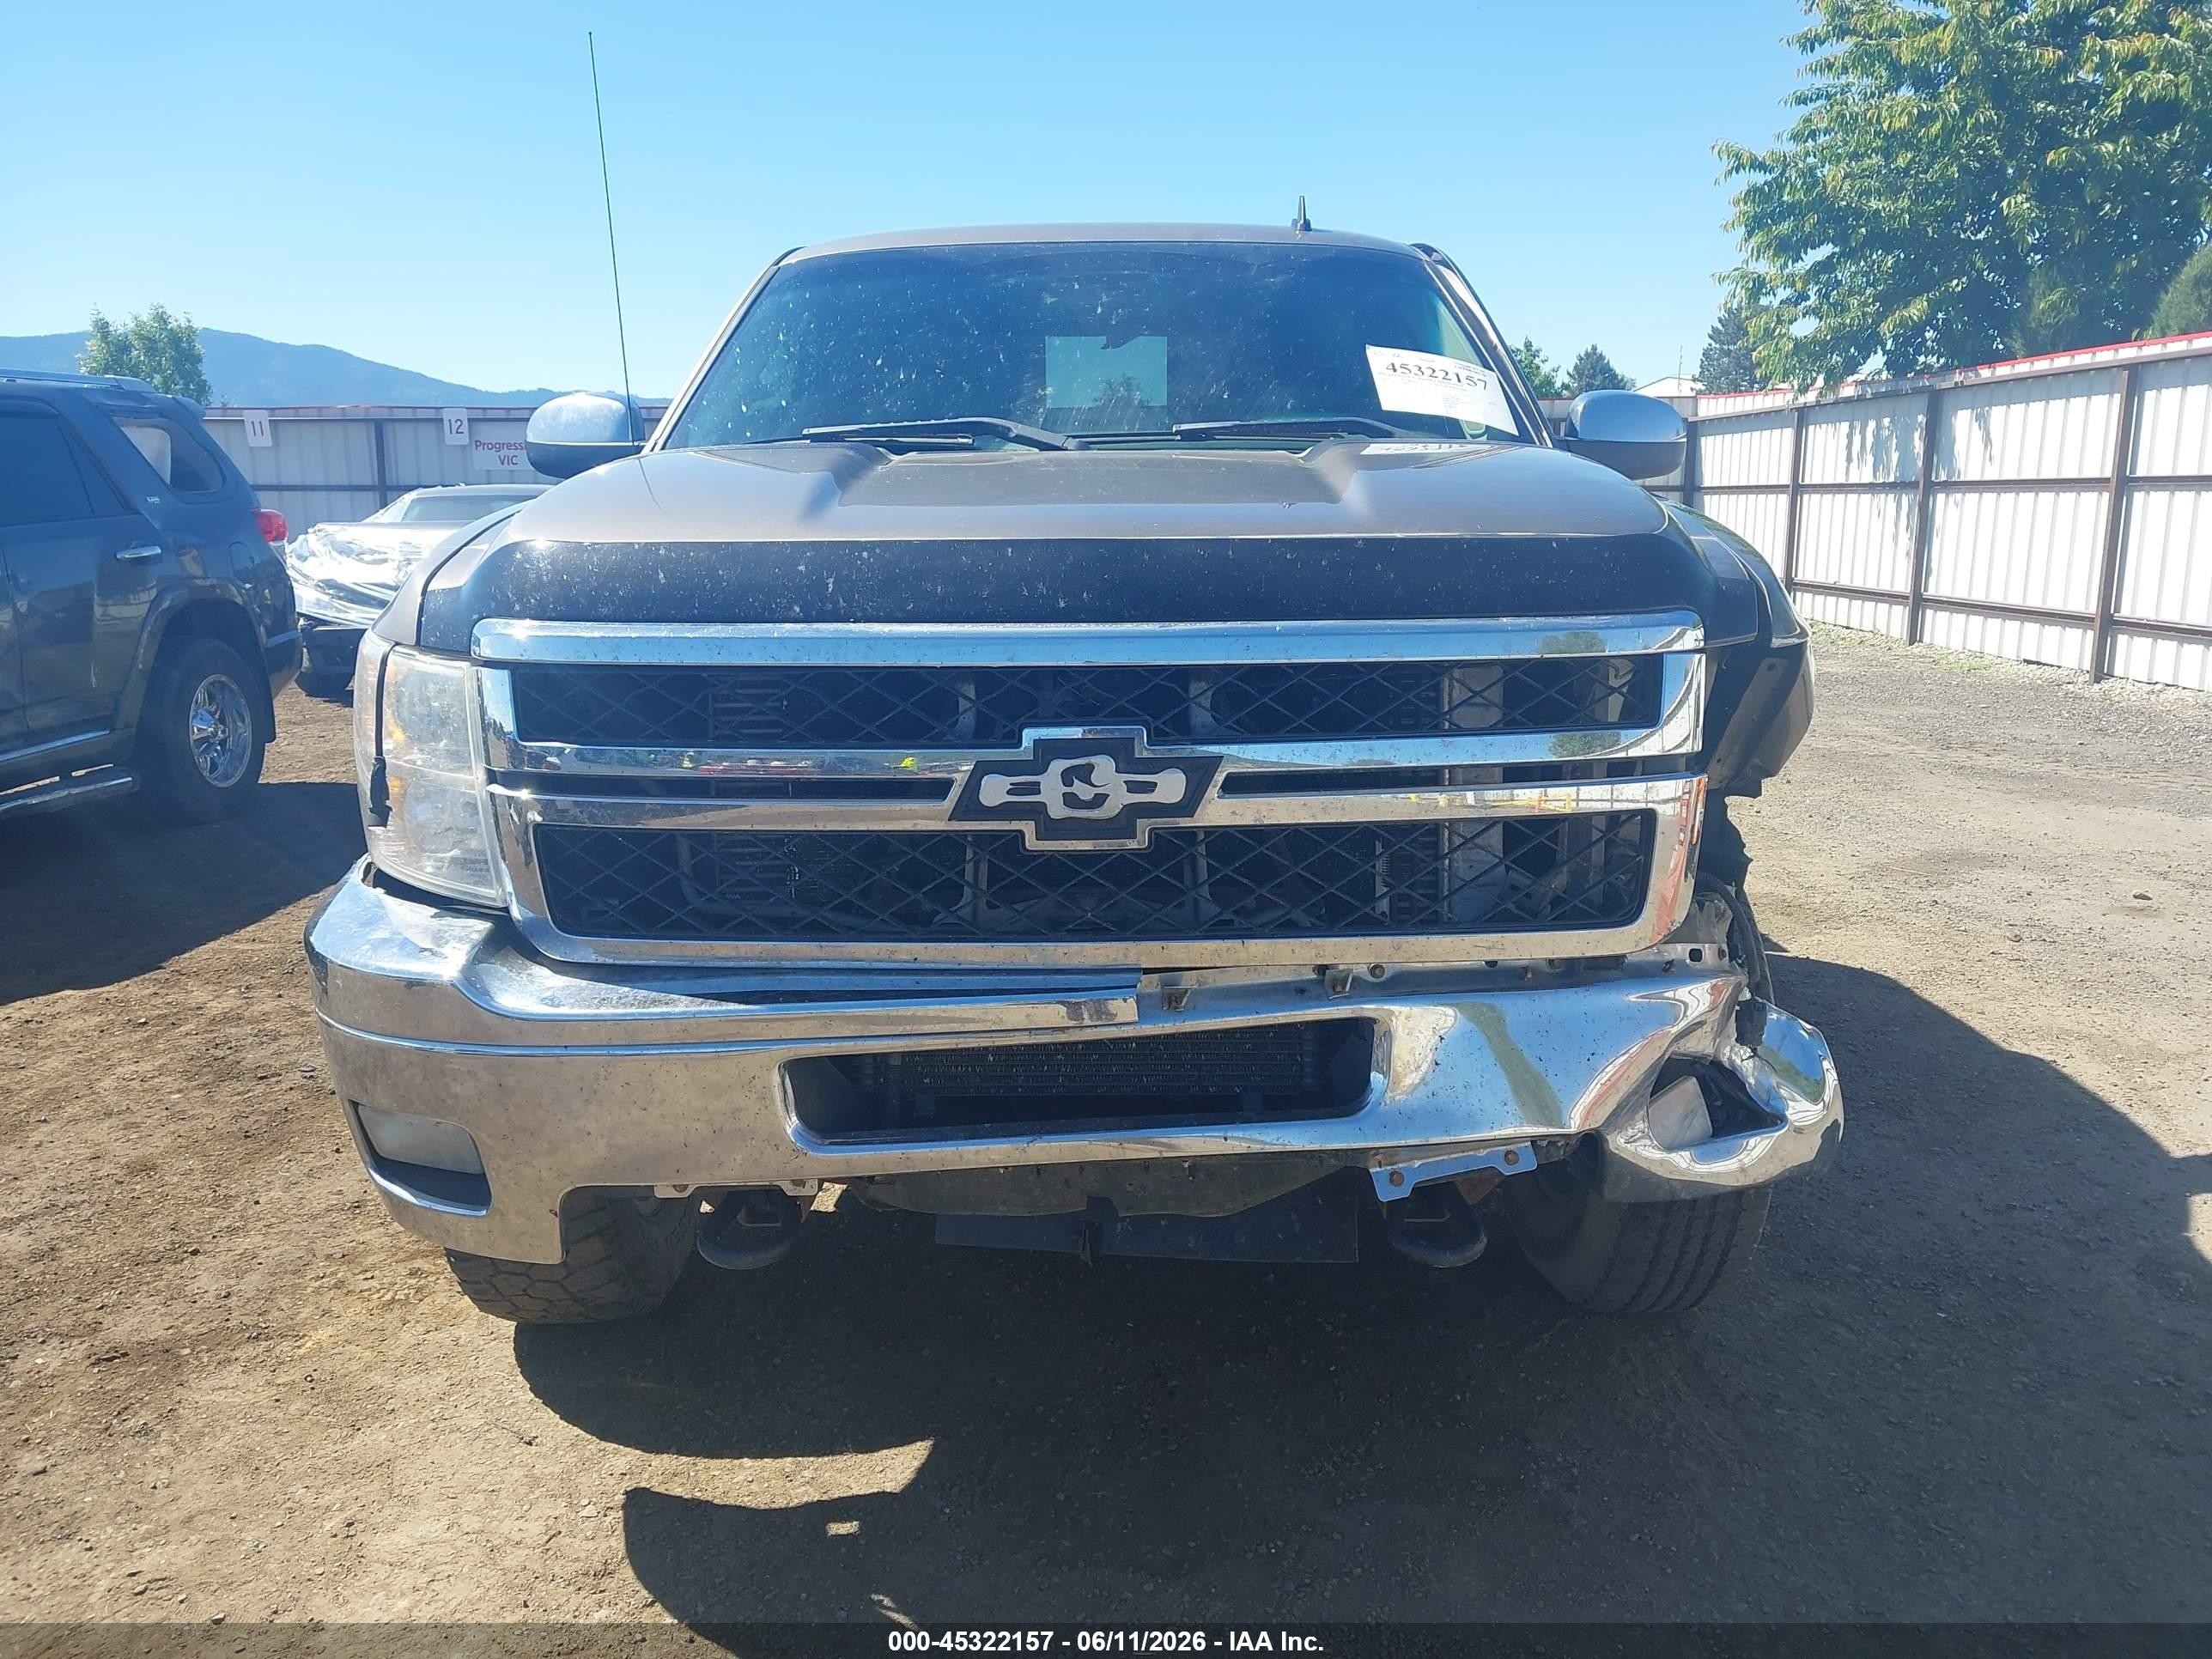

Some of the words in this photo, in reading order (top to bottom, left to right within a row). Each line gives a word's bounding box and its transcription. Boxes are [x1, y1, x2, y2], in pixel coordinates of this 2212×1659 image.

[1385, 362, 1487, 391] 45322157
[251, 421, 264, 436] 11
[447, 418, 465, 434] 12
[498, 455, 519, 465] VIC
